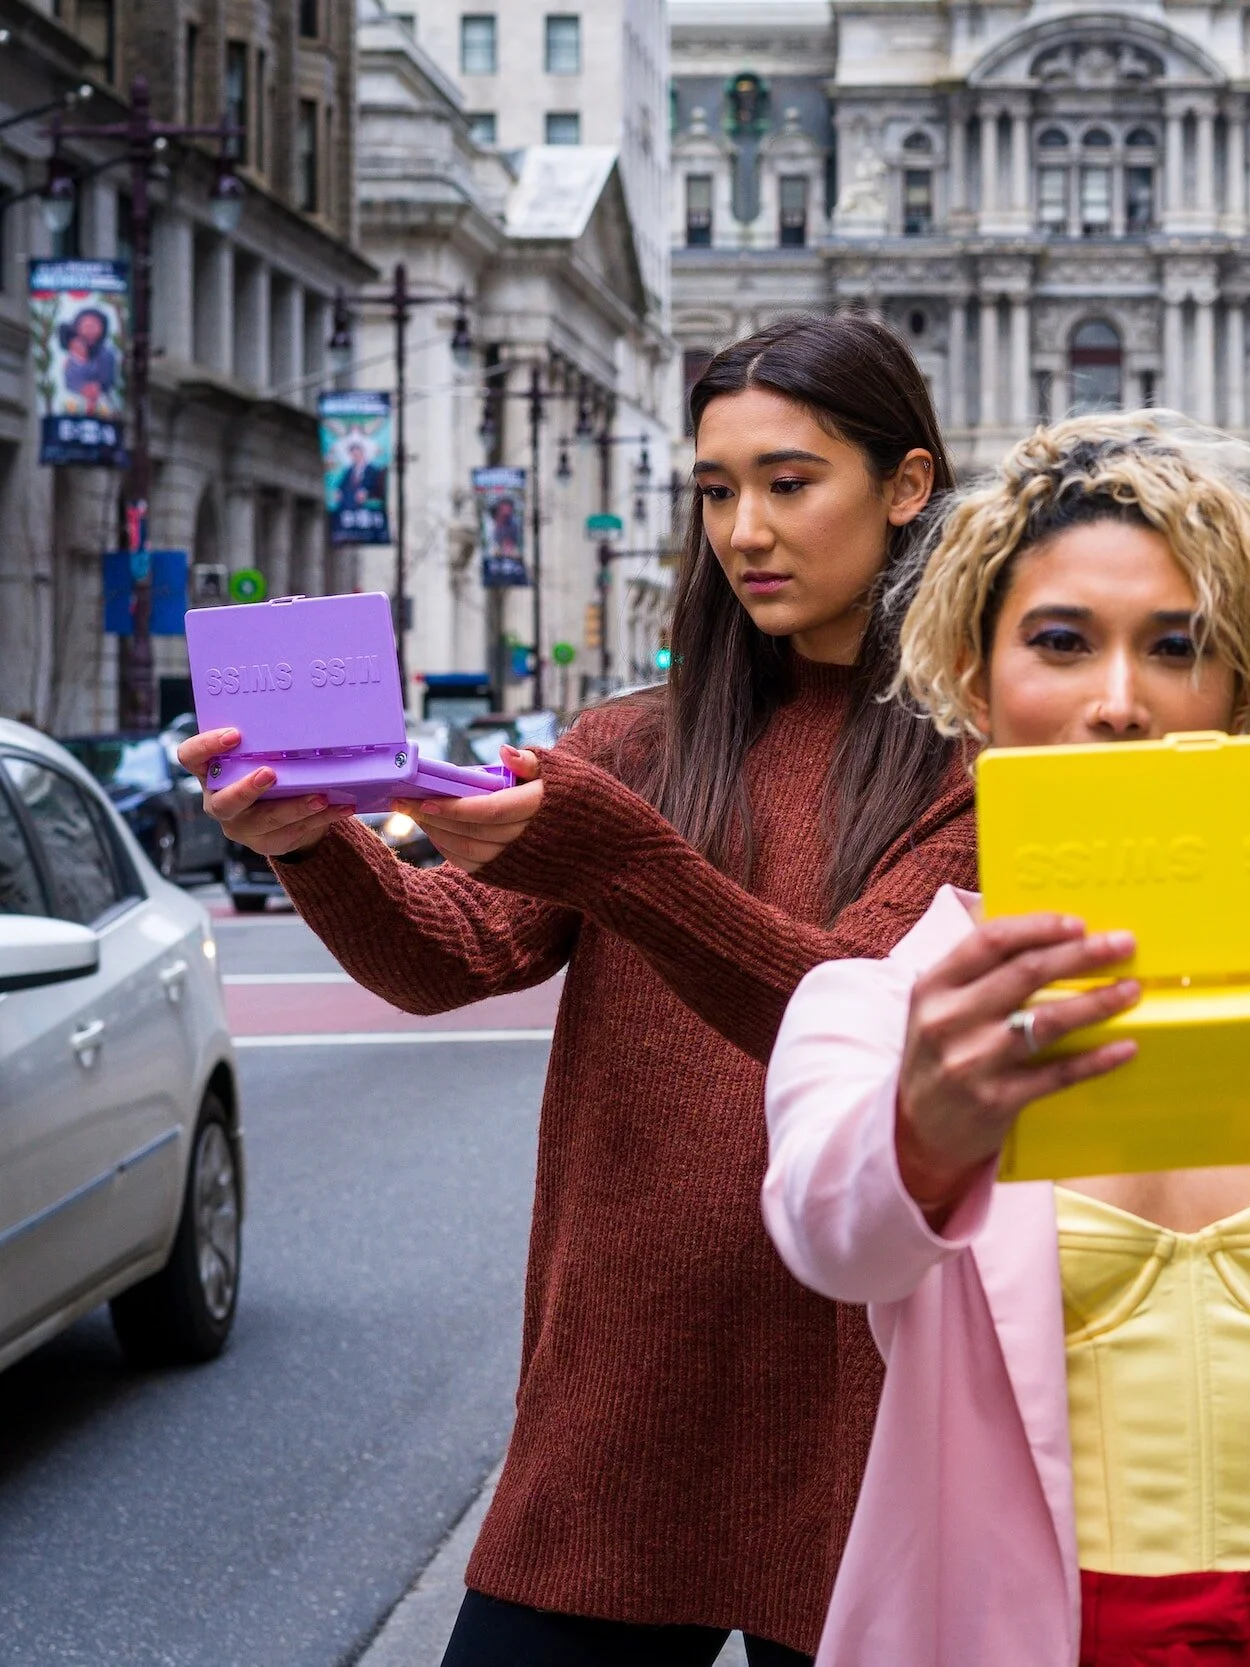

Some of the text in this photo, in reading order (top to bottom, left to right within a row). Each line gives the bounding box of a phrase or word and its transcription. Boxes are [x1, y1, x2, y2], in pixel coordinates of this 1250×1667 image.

[205, 654, 381, 696] MISS SWISS
[1013, 833, 1208, 892] SWISS
